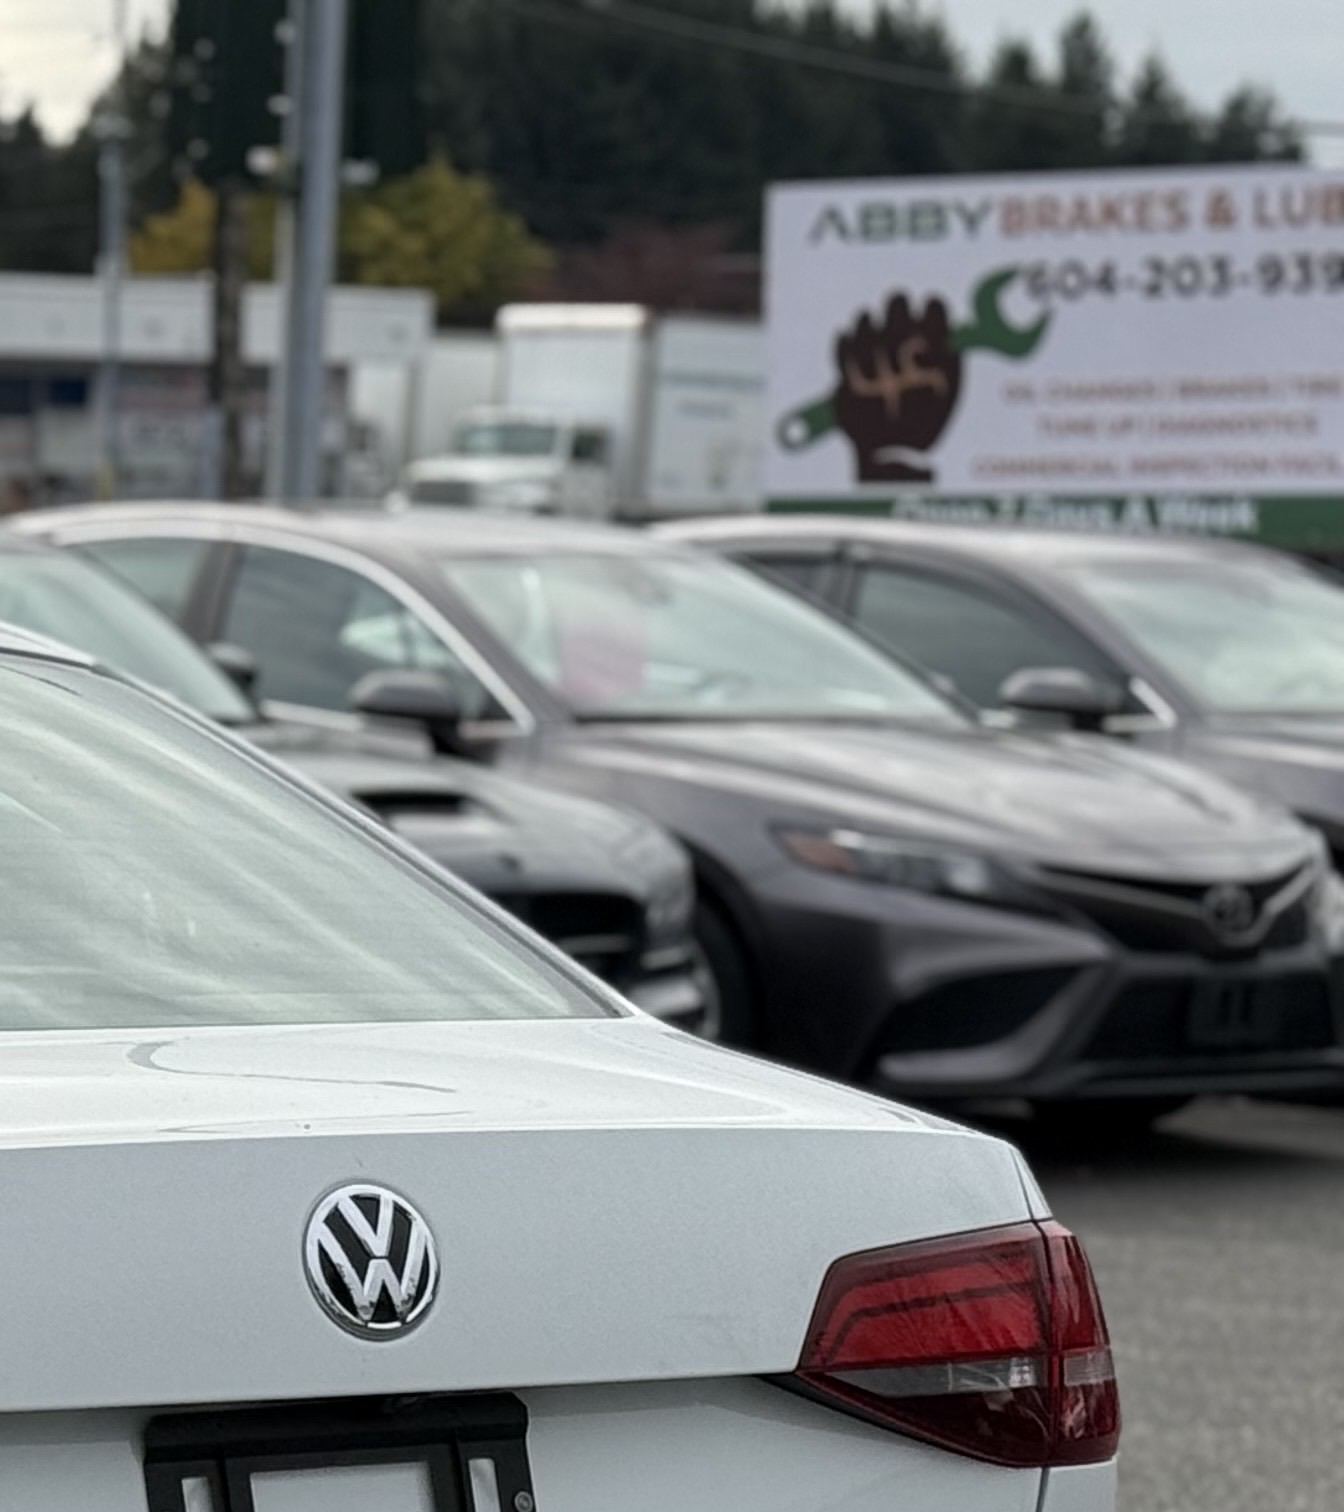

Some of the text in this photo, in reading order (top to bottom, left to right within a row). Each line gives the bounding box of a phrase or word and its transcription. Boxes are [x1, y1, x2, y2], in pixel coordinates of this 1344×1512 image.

[807, 197, 997, 243] ABBY
[999, 187, 1191, 237] BRAKES
[1204, 186, 1237, 230] &
[302, 1179, 440, 1341] VW
